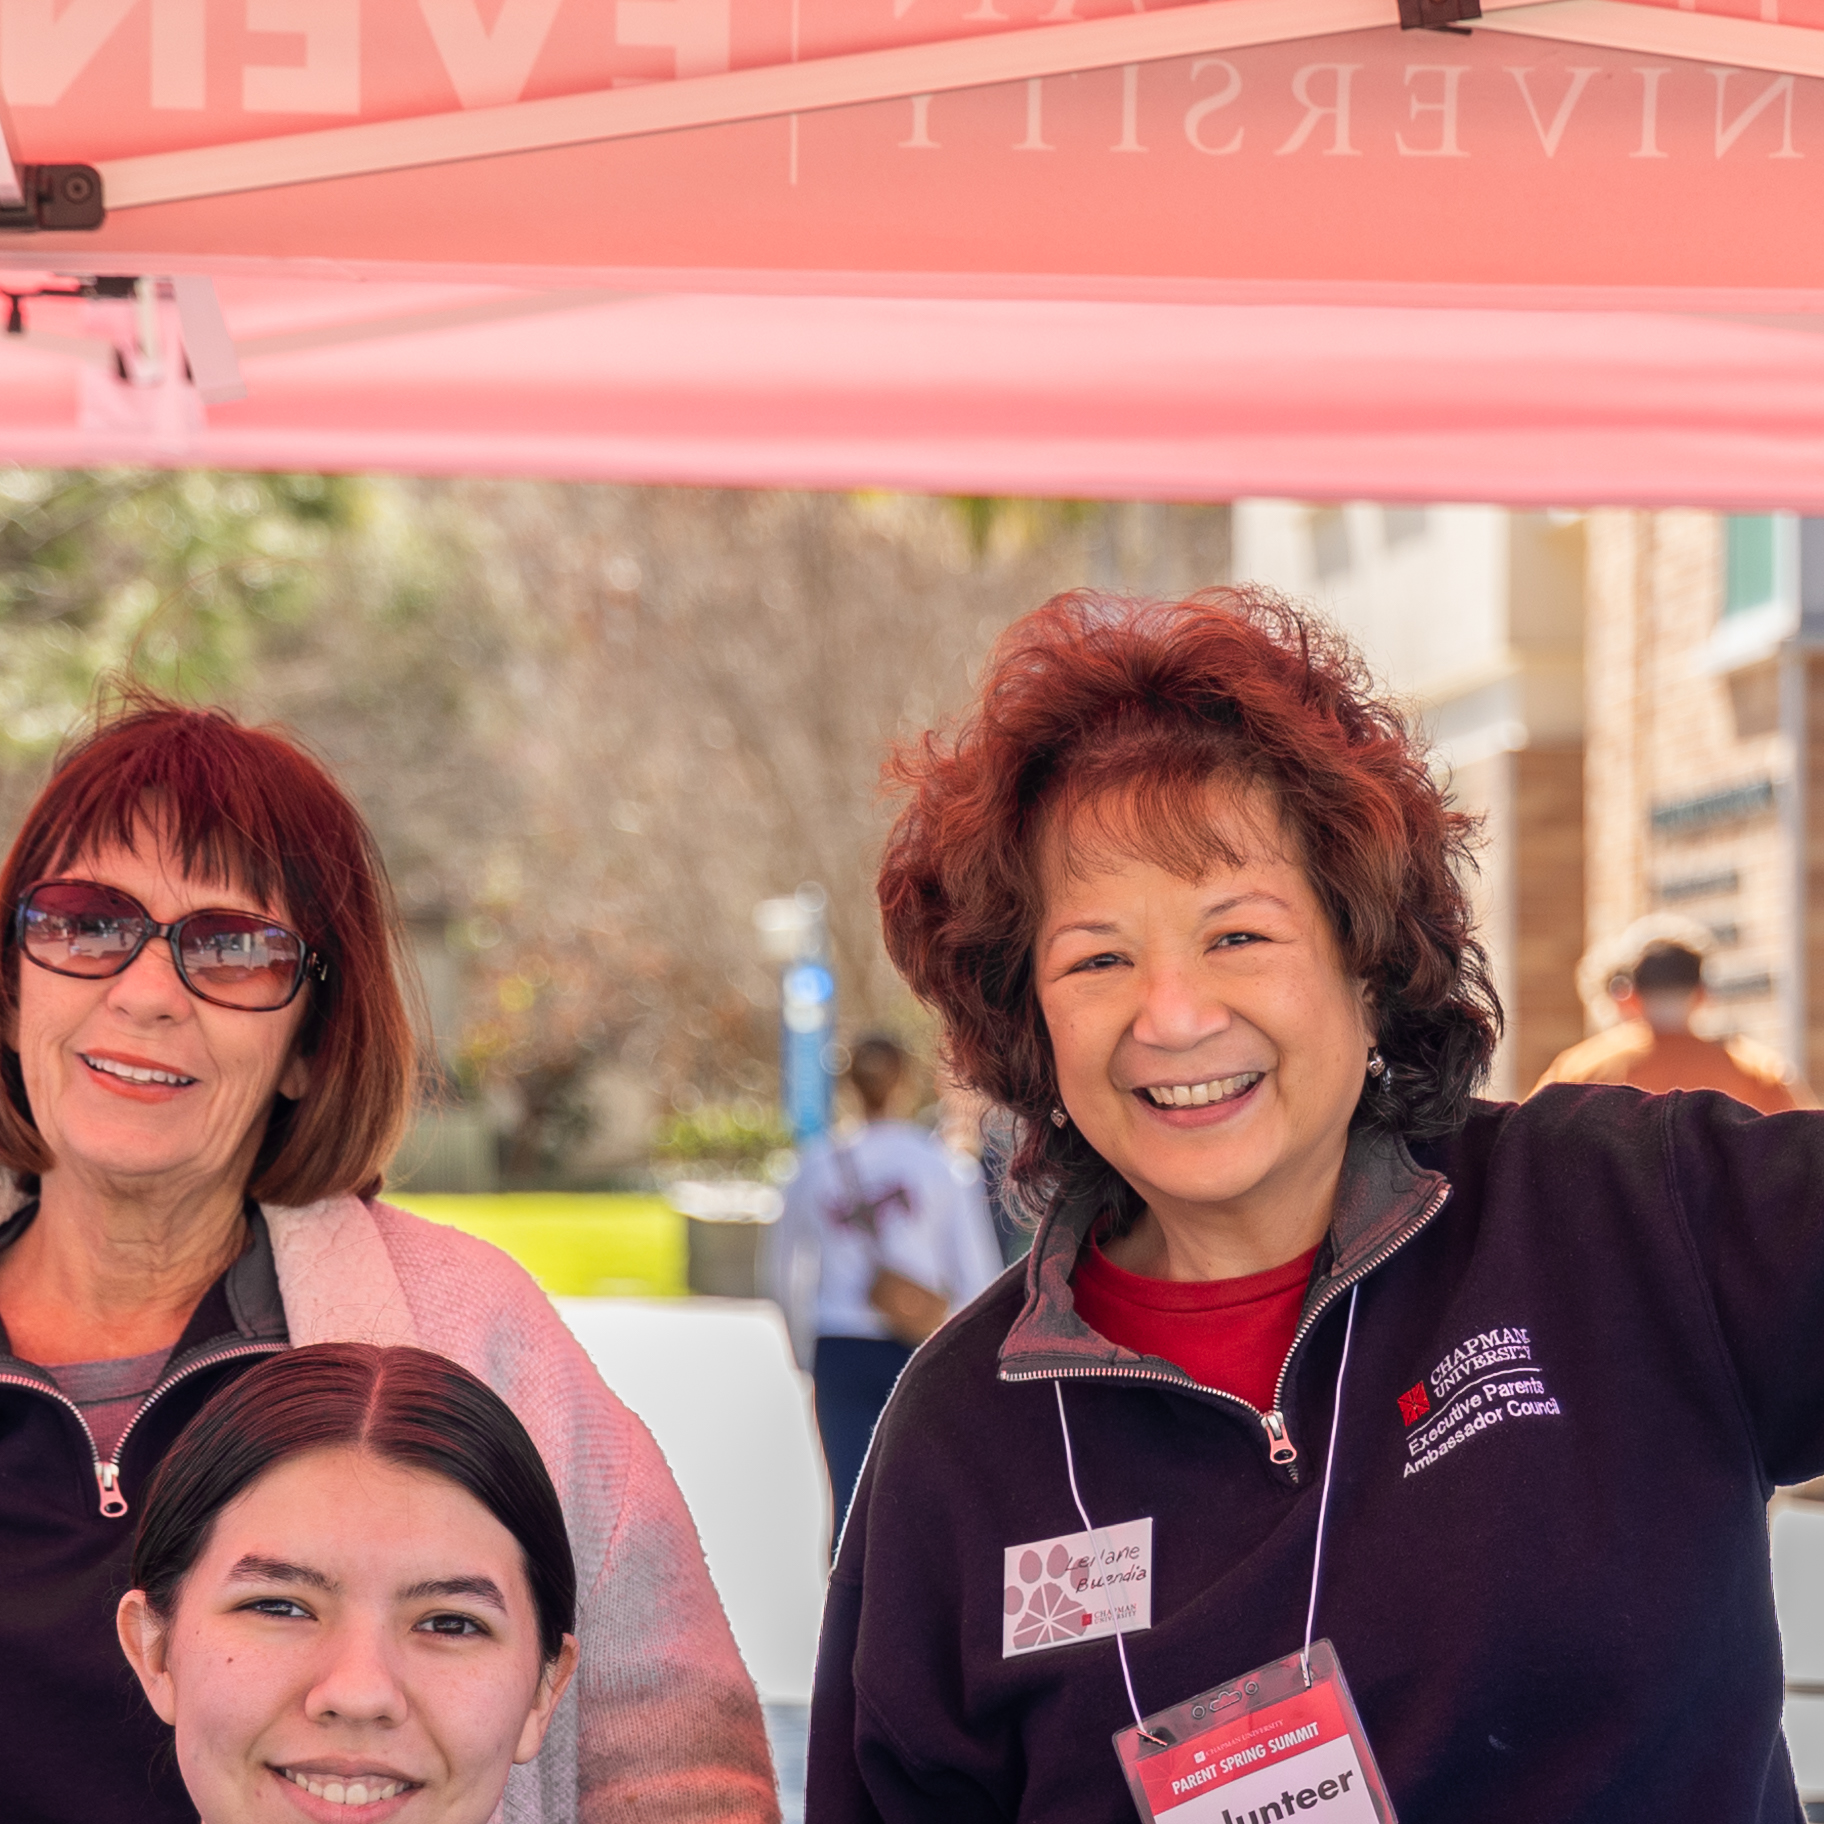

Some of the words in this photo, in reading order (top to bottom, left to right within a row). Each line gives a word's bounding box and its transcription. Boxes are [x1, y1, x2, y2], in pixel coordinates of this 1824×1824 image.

[1430, 1327, 1531, 1386] CHAPMAN
[1433, 1345, 1532, 1399] UNIVERSITY
[1403, 1406, 1503, 1479] Ambassador
[1506, 1397, 1561, 1417] Council
[1408, 1391, 1482, 1457] Executive
[1482, 1376, 1545, 1402] Parents
[1171, 1764, 1218, 1795] PARENT
[1219, 1743, 1267, 1774] SPRING
[1267, 1721, 1320, 1754] SUMMIT
[1205, 1736, 1241, 1757] CHAPMAN
[1241, 1718, 1284, 1742] UNIVERSITY
